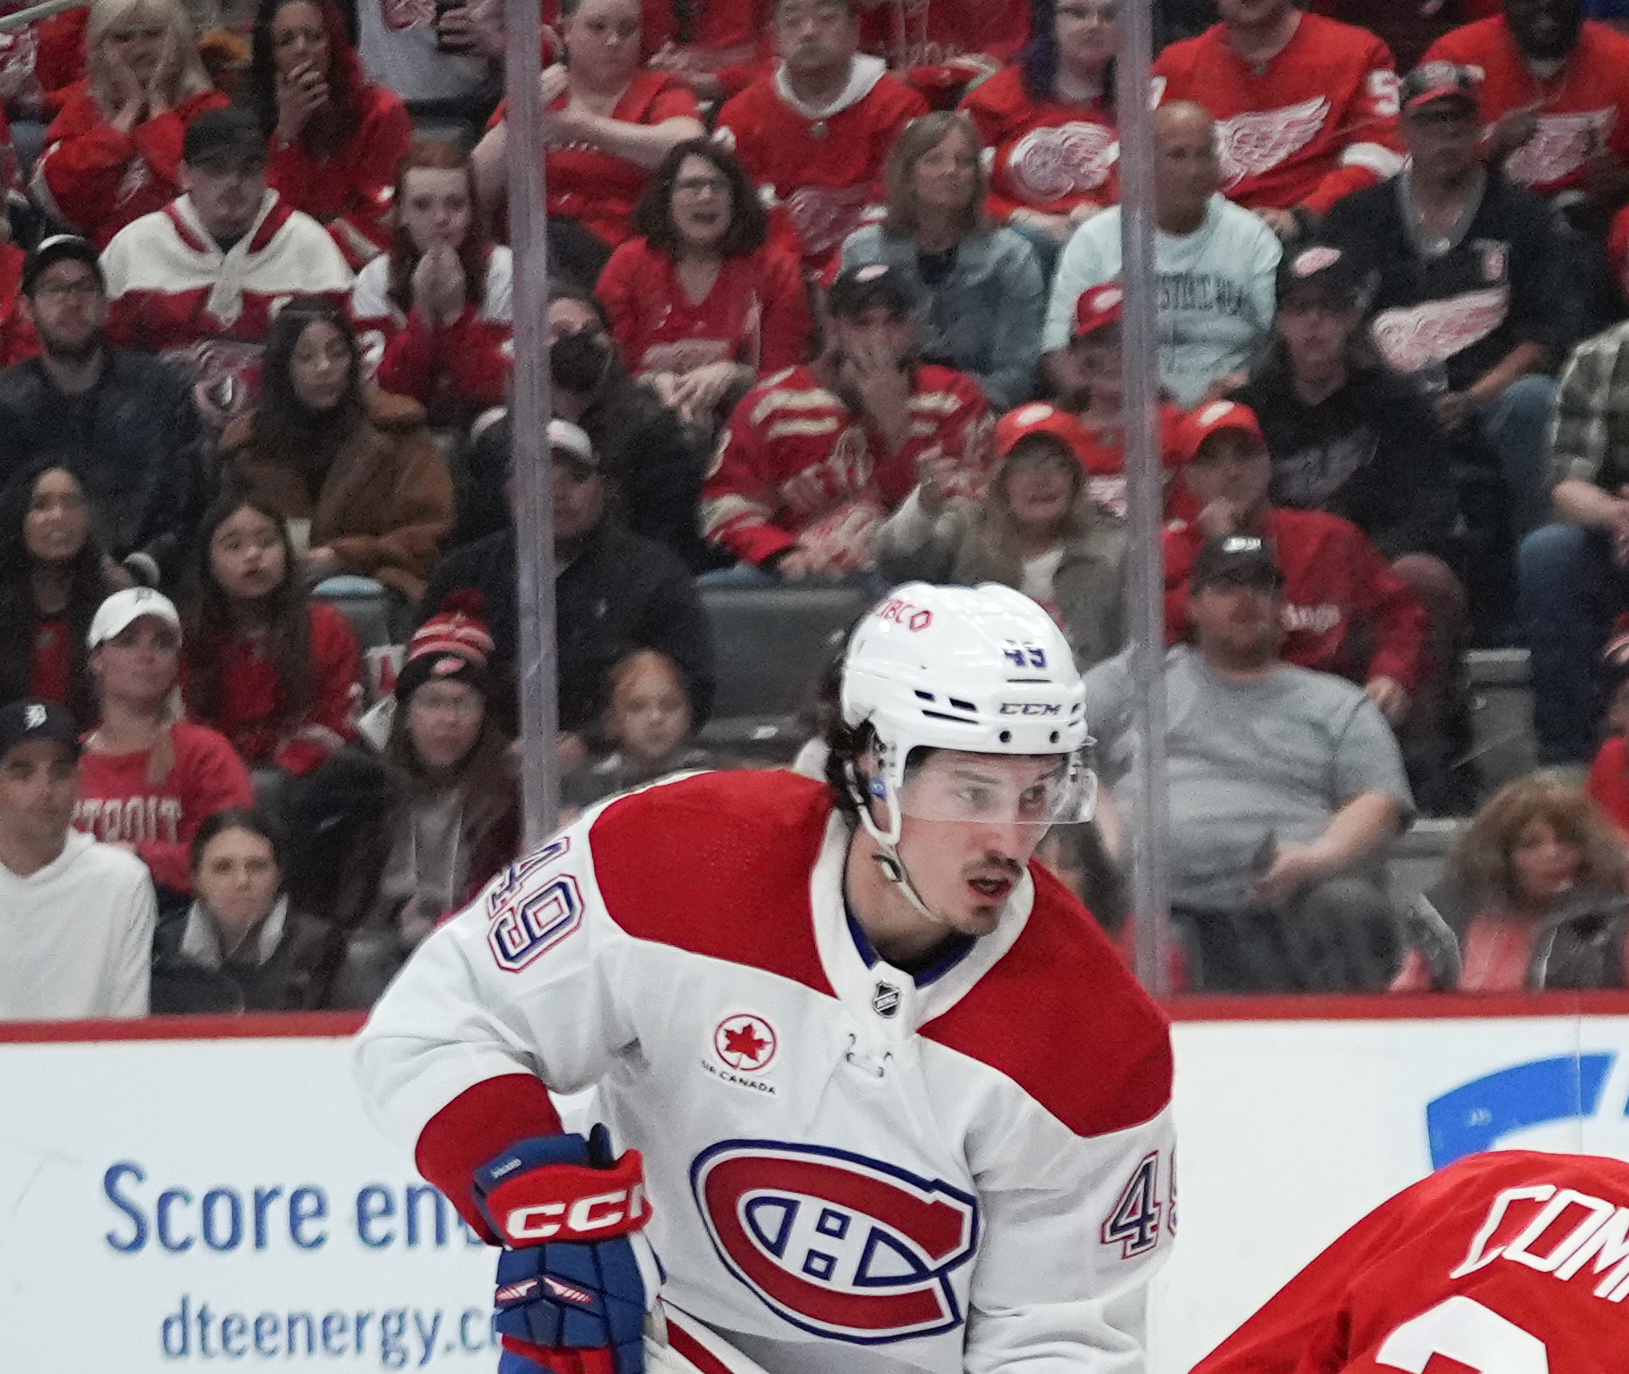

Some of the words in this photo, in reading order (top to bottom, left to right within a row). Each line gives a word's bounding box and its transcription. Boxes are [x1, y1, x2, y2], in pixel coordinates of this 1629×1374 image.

[999, 703, 1063, 716] CCM
[719, 1070, 776, 1096] CANADA
[103, 1159, 328, 1254] Score
